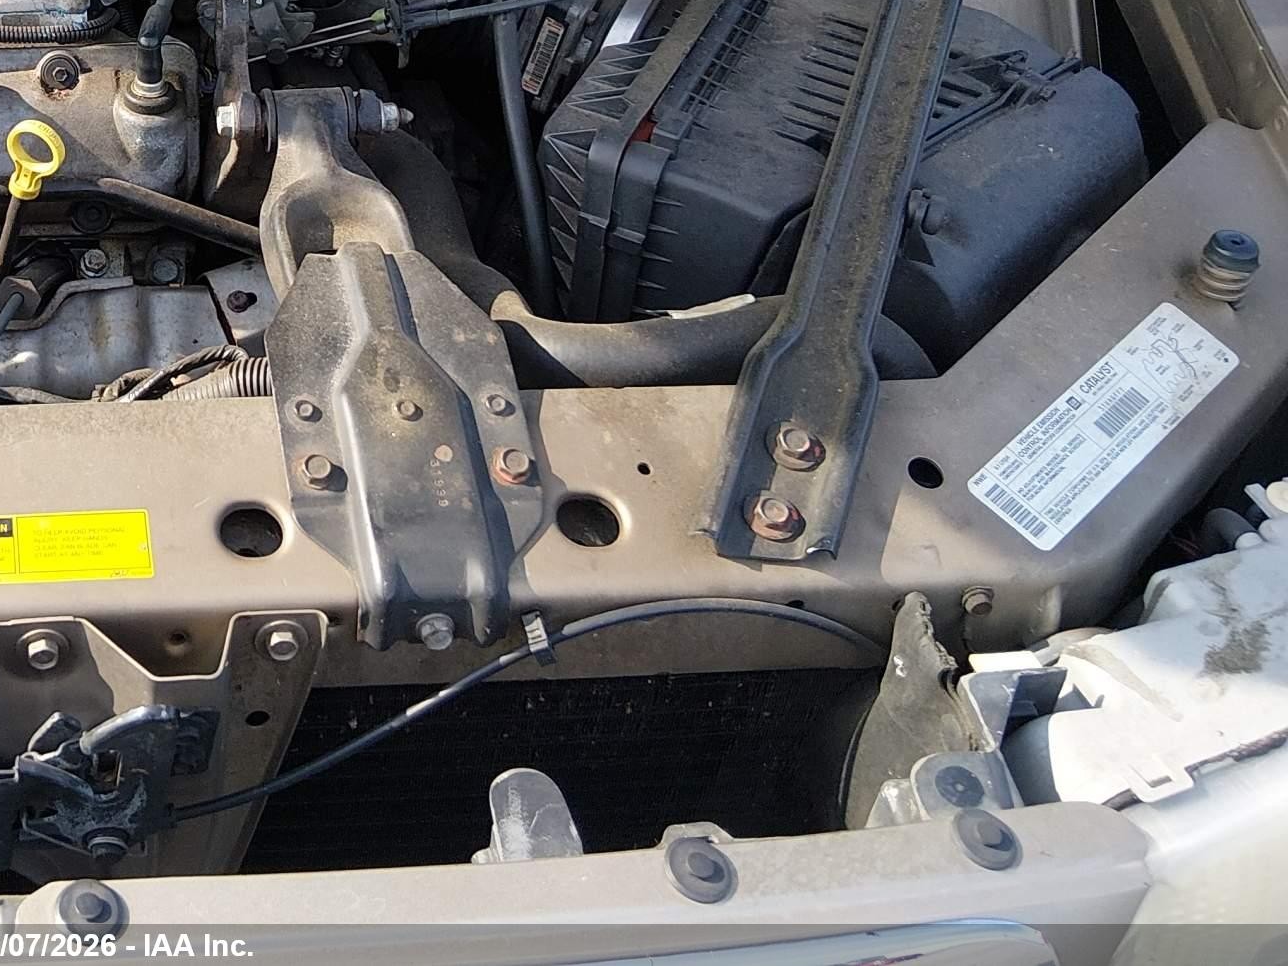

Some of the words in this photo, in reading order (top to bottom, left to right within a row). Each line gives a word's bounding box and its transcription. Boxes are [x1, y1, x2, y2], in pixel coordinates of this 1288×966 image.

[1079, 361, 1115, 395] CATALYST
[1017, 434, 1043, 458] CONTROL
[1040, 406, 1073, 436] INFORMATION
[1018, 426, 1039, 446] VEHICLE
[1037, 407, 1060, 428] EMISSION
